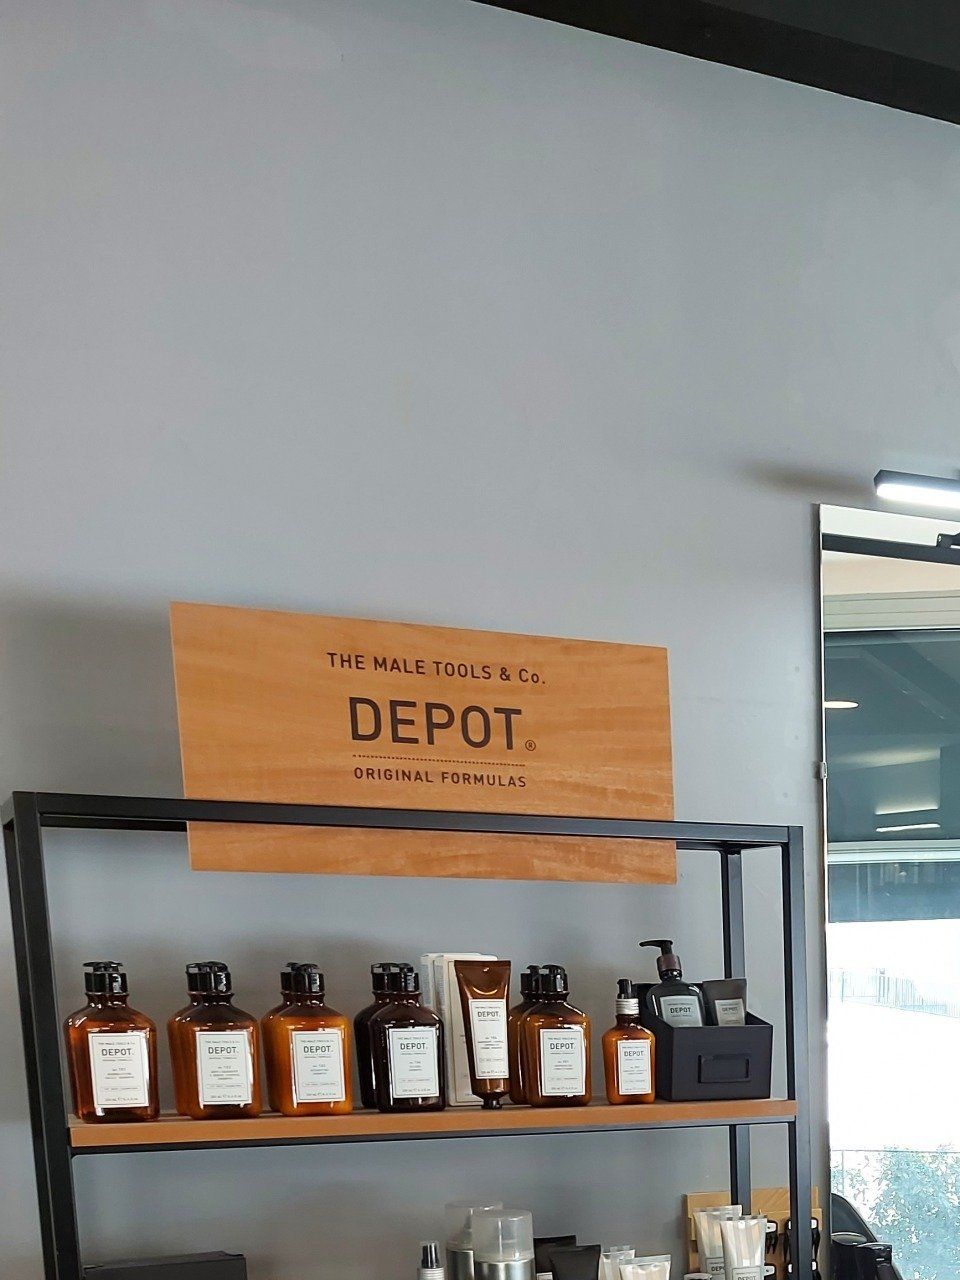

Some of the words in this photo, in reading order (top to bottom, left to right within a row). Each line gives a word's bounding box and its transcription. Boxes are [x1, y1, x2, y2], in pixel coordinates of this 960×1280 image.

[327, 652, 365, 670] THE
[373, 656, 425, 675] MALE
[433, 661, 492, 680] TOOLS
[499, 667, 511, 681] &
[518, 668, 546, 684] Co.
[353, 766, 434, 783] ORIGINAL
[441, 771, 527, 787] FORMULAS
[207, 1046, 239, 1054] DEPOT
[303, 1045, 333, 1054] DEPOT
[400, 1042, 428, 1051] DEPOT
[550, 1042, 575, 1050] DEPOT
[101, 1048, 135, 1056] DEPOT
[623, 1050, 645, 1058] DEPOT
